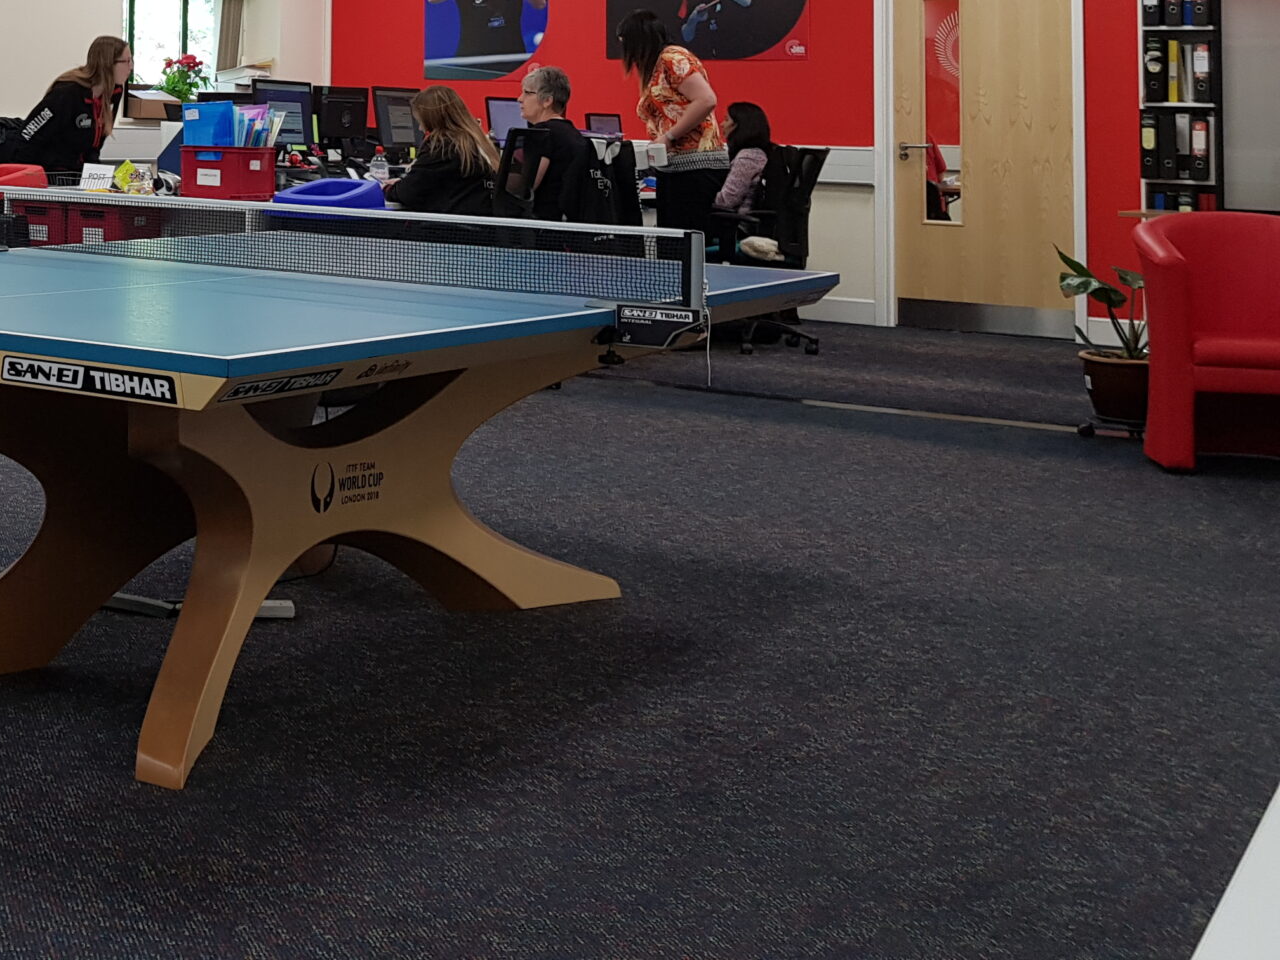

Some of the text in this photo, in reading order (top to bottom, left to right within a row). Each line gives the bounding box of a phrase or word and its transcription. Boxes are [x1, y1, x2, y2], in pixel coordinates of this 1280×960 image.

[660, 312, 690, 321] TIBHAR
[7, 361, 171, 400] SAN-EI TIBHAR
[284, 371, 334, 390] TIBHAR
[345, 461, 376, 473] ITTF TEAM
[338, 472, 384, 492] WORLD CUP
[341, 493, 366, 505] LONDON
